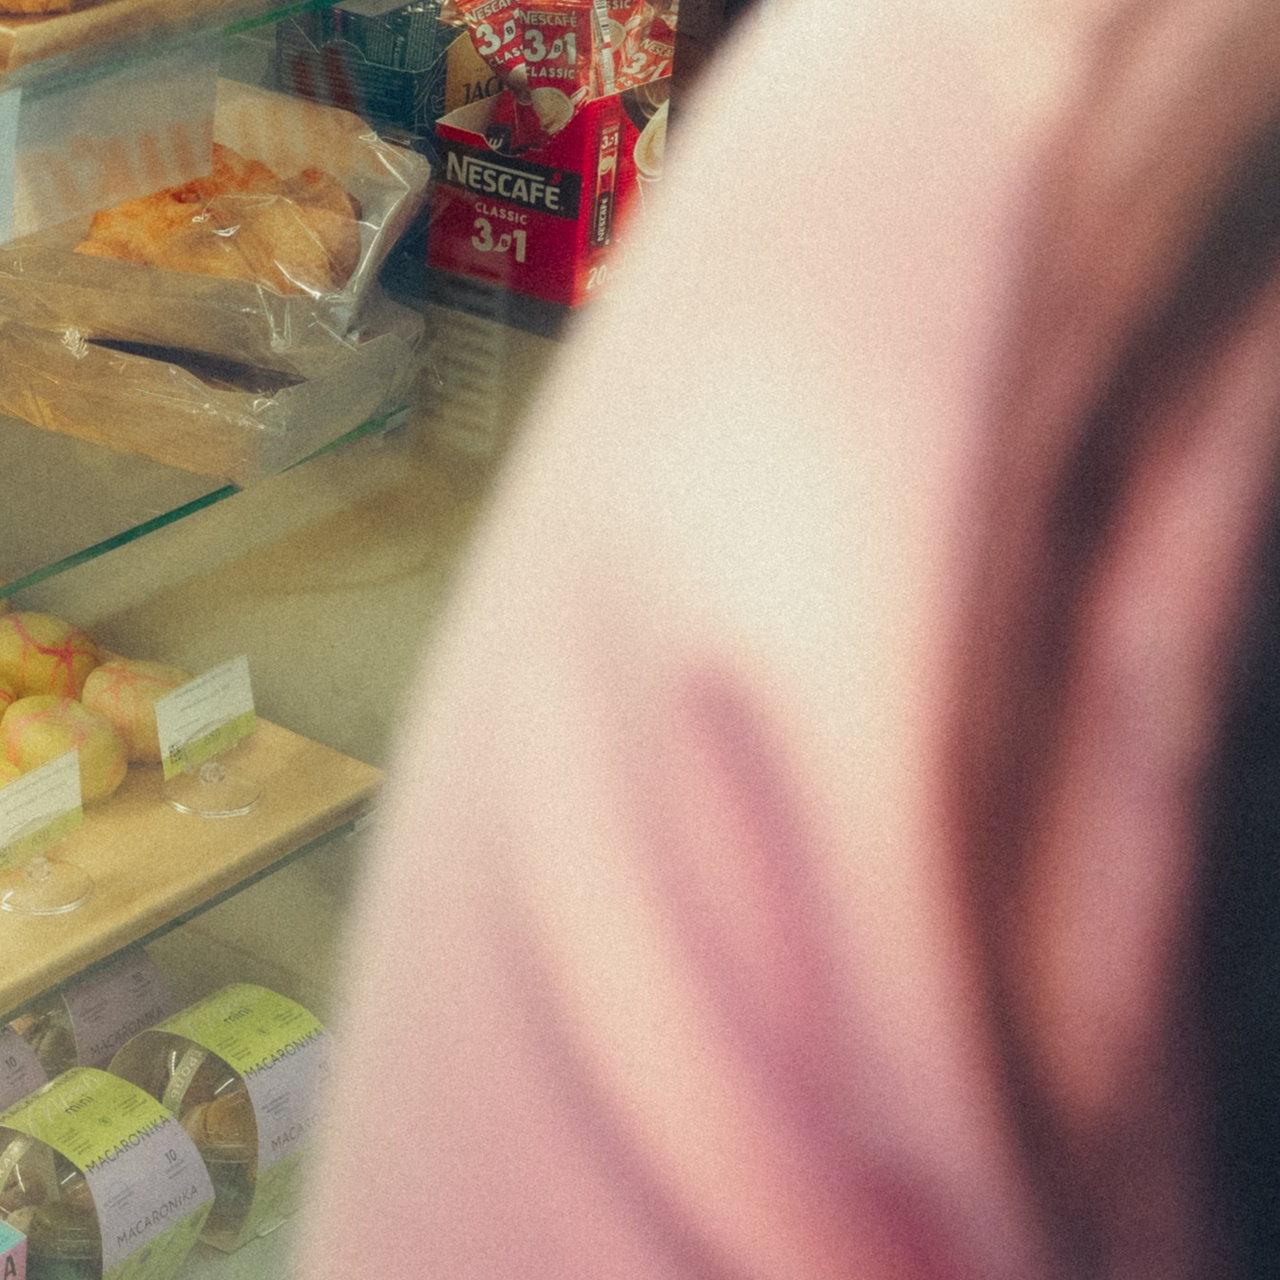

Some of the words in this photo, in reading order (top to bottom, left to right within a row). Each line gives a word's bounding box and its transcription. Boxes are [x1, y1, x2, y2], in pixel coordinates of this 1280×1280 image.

[524, 66, 577, 80] CLASSIC
[475, 202, 527, 225] CLASSIC
[85, 1113, 173, 1176] MACARONIKA
[165, 1148, 178, 1164] 10
[116, 1183, 198, 1248] MACARONIKA
